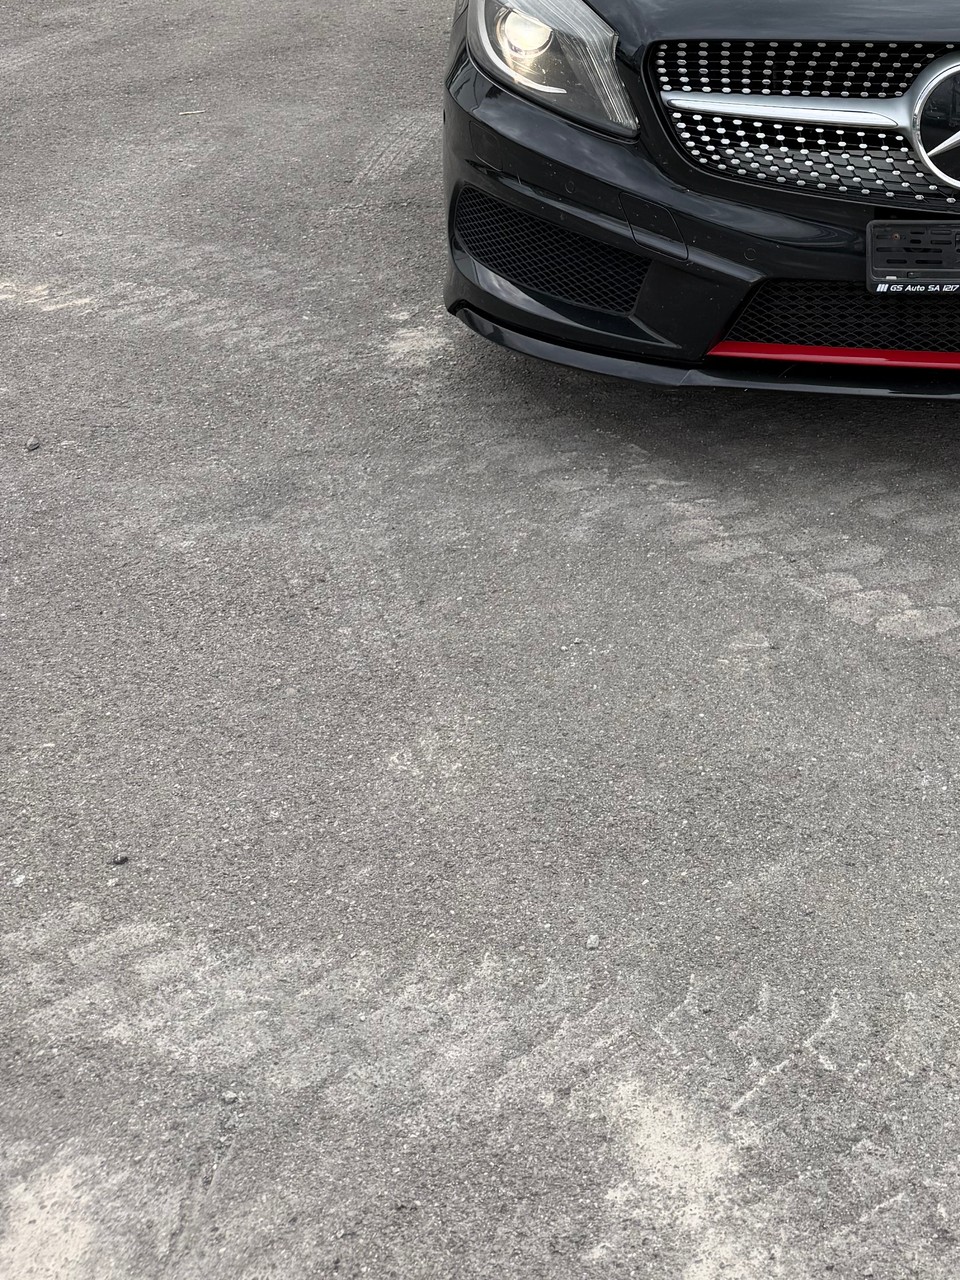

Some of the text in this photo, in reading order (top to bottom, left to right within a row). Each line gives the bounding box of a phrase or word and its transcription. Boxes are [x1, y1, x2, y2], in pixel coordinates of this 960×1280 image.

[890, 284, 904, 292] GS
[905, 284, 925, 292] Auto
[927, 284, 940, 292] SA
[942, 284, 960, 292] 1217
